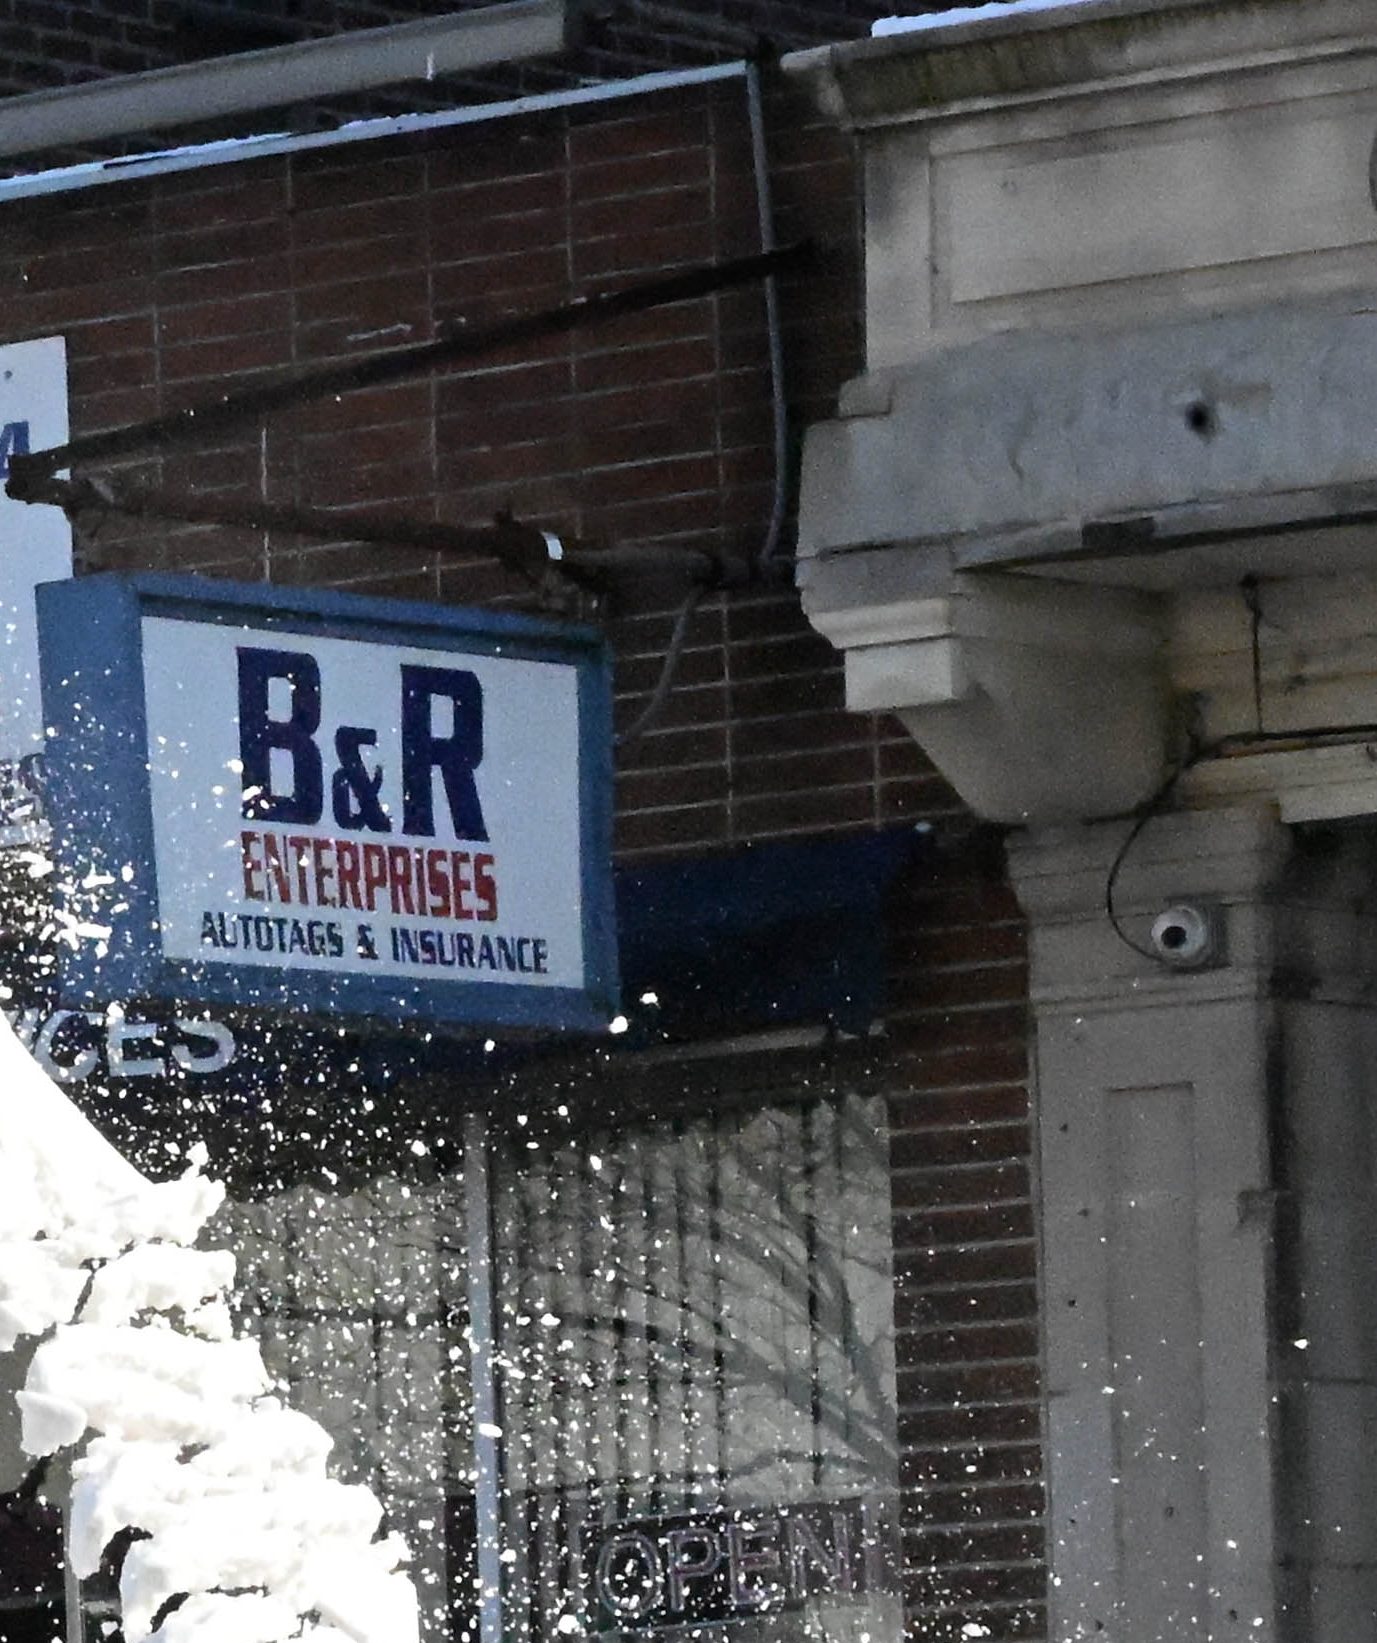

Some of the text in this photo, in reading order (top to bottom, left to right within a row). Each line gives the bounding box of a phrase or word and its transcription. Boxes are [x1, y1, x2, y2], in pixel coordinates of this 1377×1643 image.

[236, 646, 490, 842] B&R
[241, 831, 499, 922] ENTERPRISES
[200, 911, 549, 974] AUTOTAGS & INSURANCE
[596, 1512, 853, 1618] OPEN
